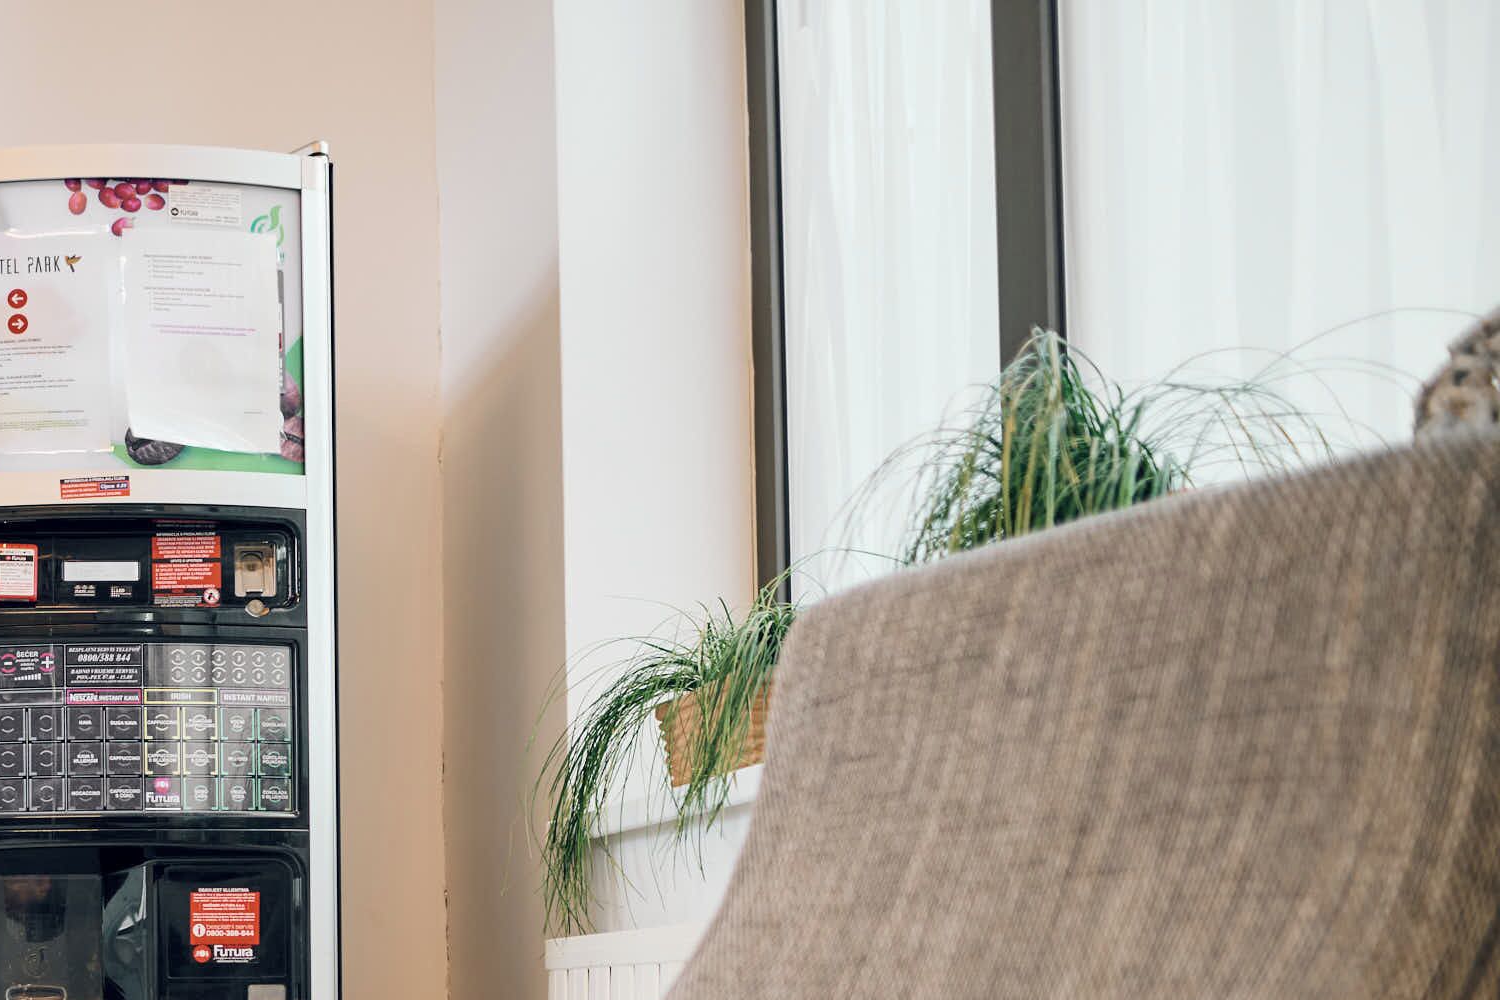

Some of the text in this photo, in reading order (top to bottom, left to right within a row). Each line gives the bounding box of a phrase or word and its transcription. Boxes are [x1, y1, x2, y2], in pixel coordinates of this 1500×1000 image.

[28, 255, 60, 273] PARK
[77, 653, 131, 662] 0800/388 844
[146, 792, 180, 803] Futura
[213, 945, 253, 957] Futura
